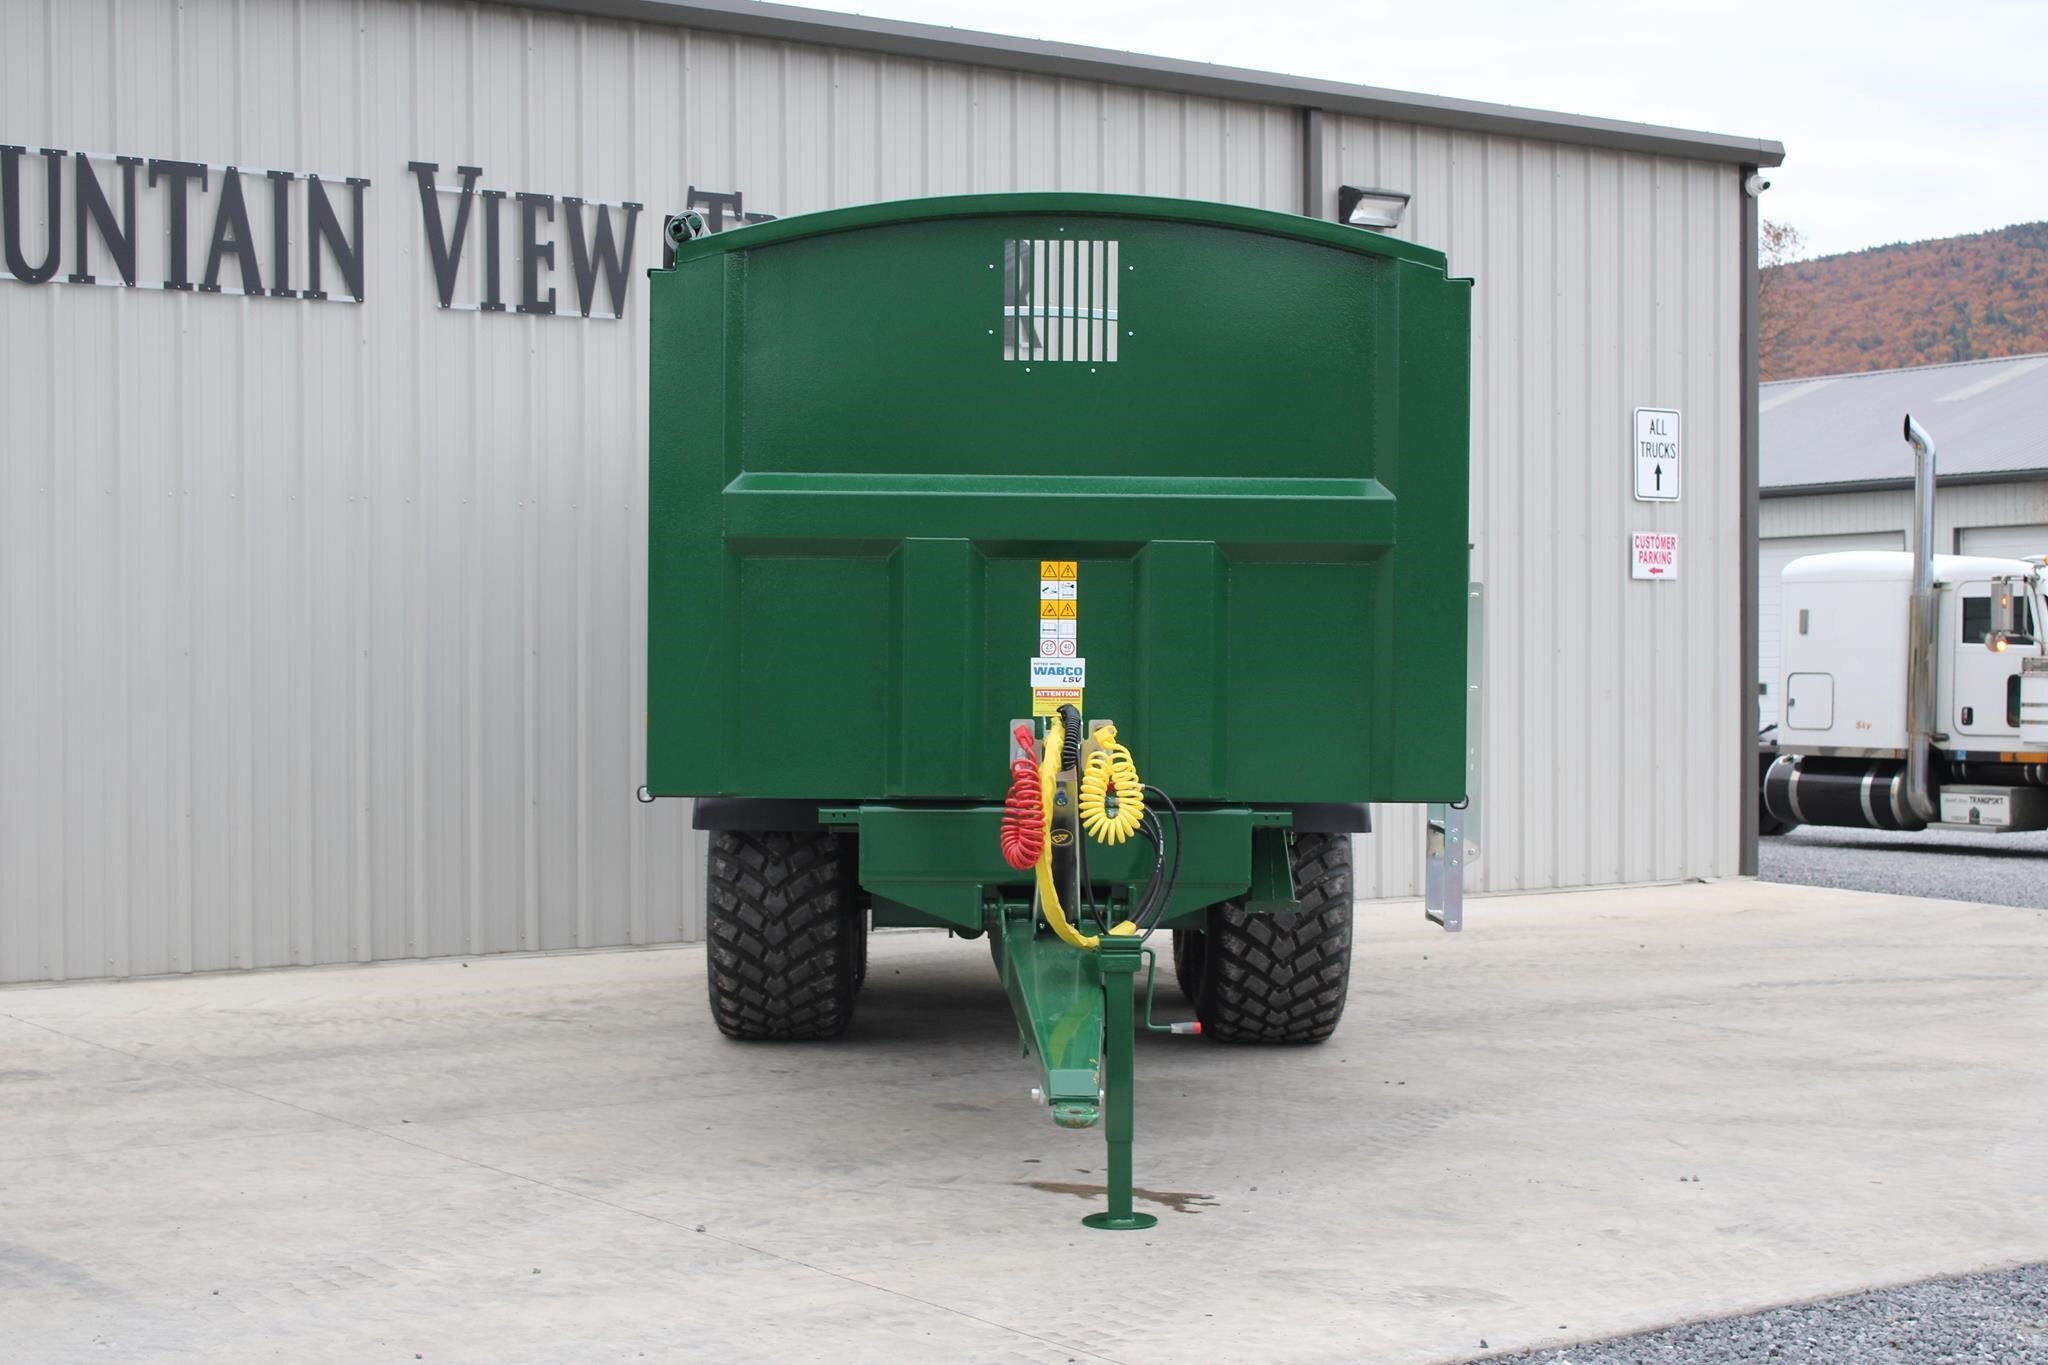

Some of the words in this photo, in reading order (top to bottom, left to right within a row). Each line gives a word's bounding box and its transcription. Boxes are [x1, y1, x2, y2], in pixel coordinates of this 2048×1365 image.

[0, 144, 371, 303] UNTAIN
[408, 161, 644, 319] VIEW
[1649, 418, 1668, 436] ALL
[1640, 441, 1676, 459] TRUCKS
[1634, 534, 1677, 551] CUSTOMER
[1638, 551, 1673, 565] PARKING
[1034, 666, 1082, 676] WABCO
[1968, 796, 2004, 805] TRANSPORT
